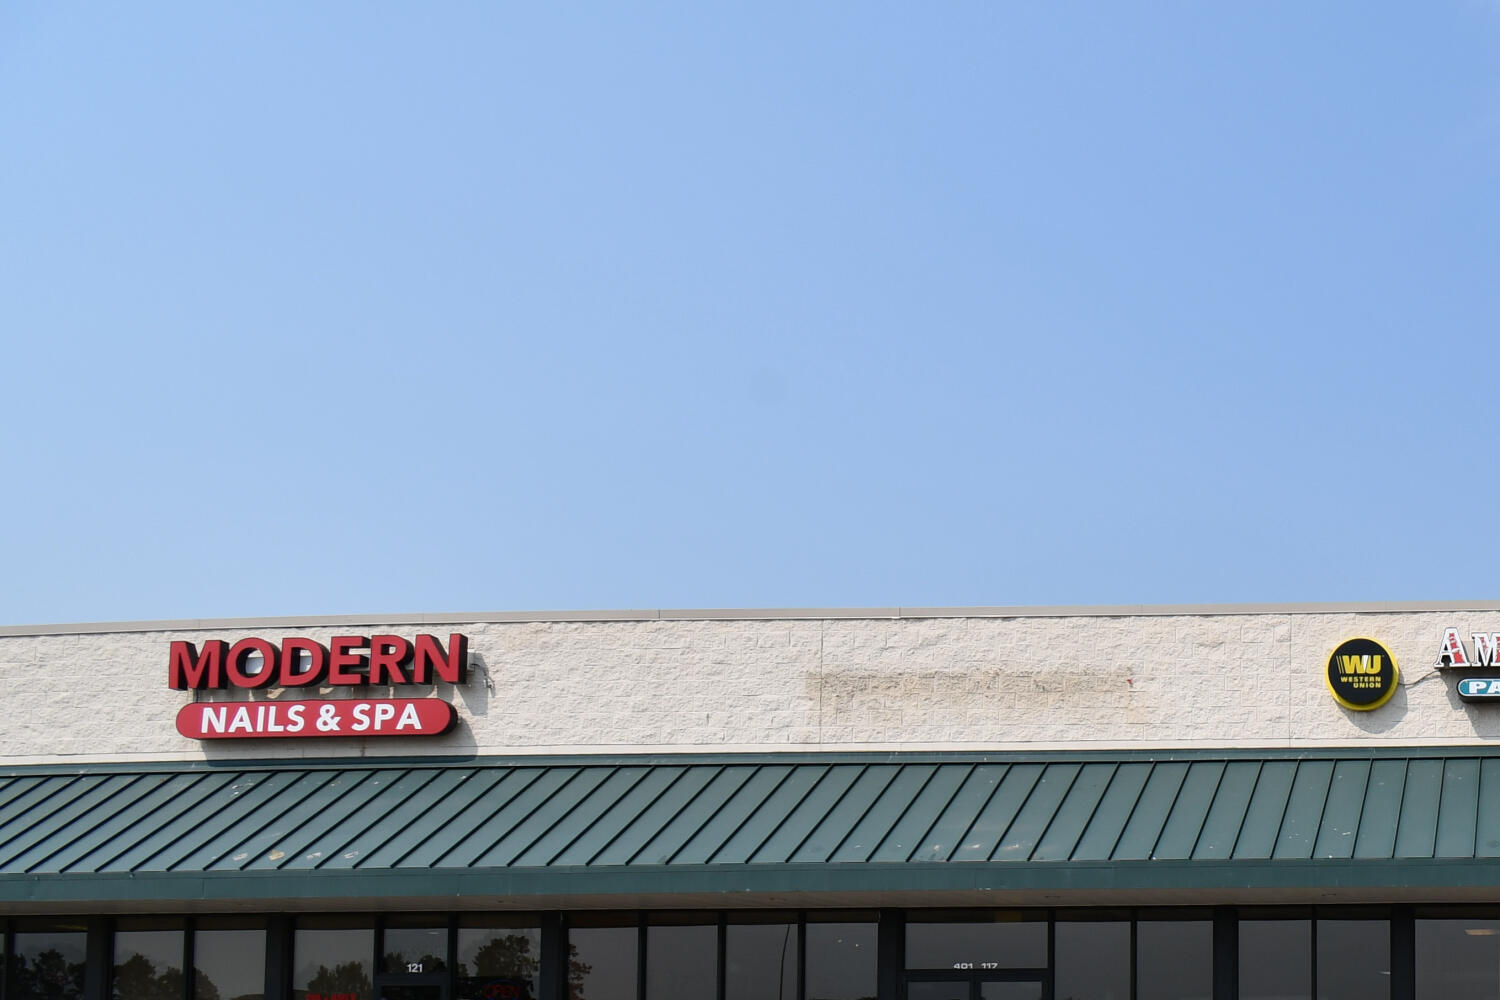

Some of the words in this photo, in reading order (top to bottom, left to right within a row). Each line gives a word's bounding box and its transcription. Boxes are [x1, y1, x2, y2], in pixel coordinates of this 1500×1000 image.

[168, 633, 469, 690] MODERN
[1337, 655, 1382, 674] WU
[200, 704, 306, 734] NAILS
[315, 704, 342, 731] &
[351, 703, 423, 730] SPA
[406, 963, 424, 973] 121
